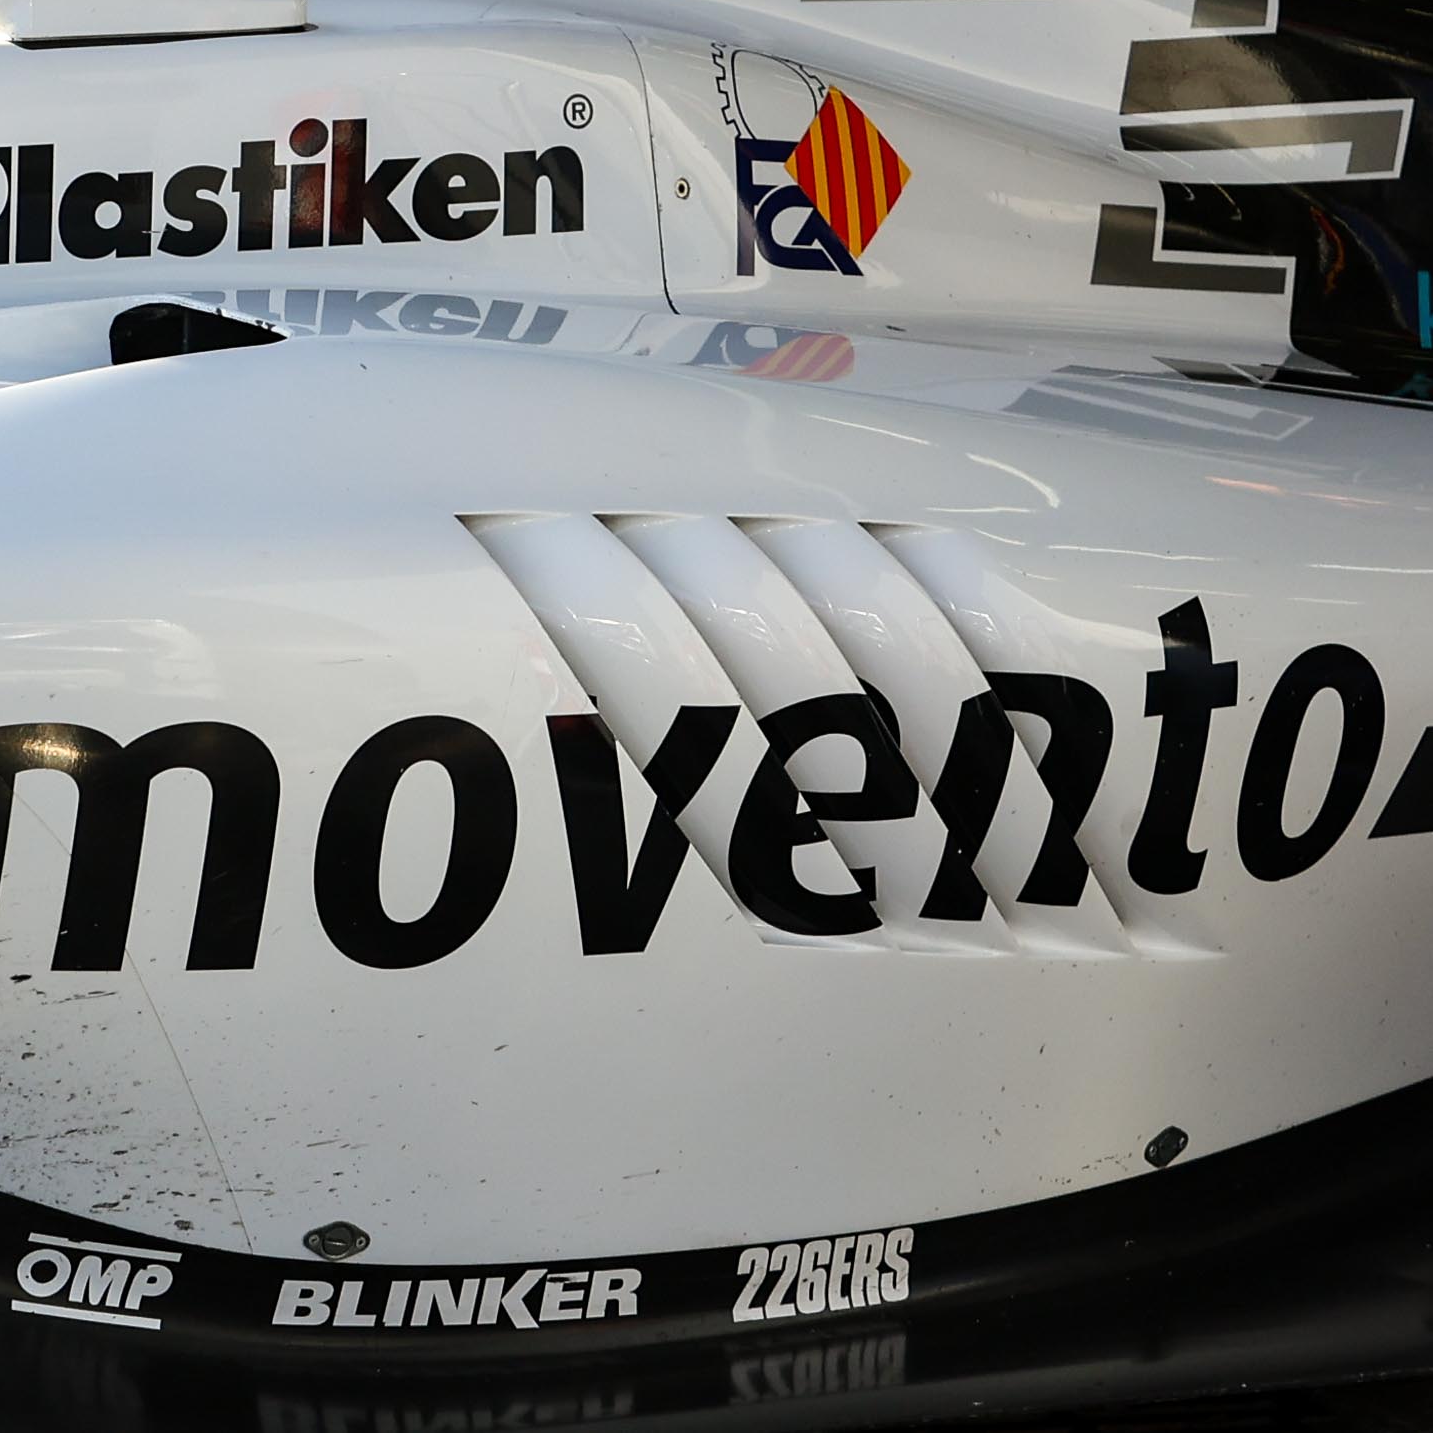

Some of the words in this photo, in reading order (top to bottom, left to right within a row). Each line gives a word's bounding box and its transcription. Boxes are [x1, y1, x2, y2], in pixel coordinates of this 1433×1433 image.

[16, 1248, 174, 1310] OMP
[272, 1269, 642, 1329] BLINKER
[733, 1228, 914, 1323] 226ERS
